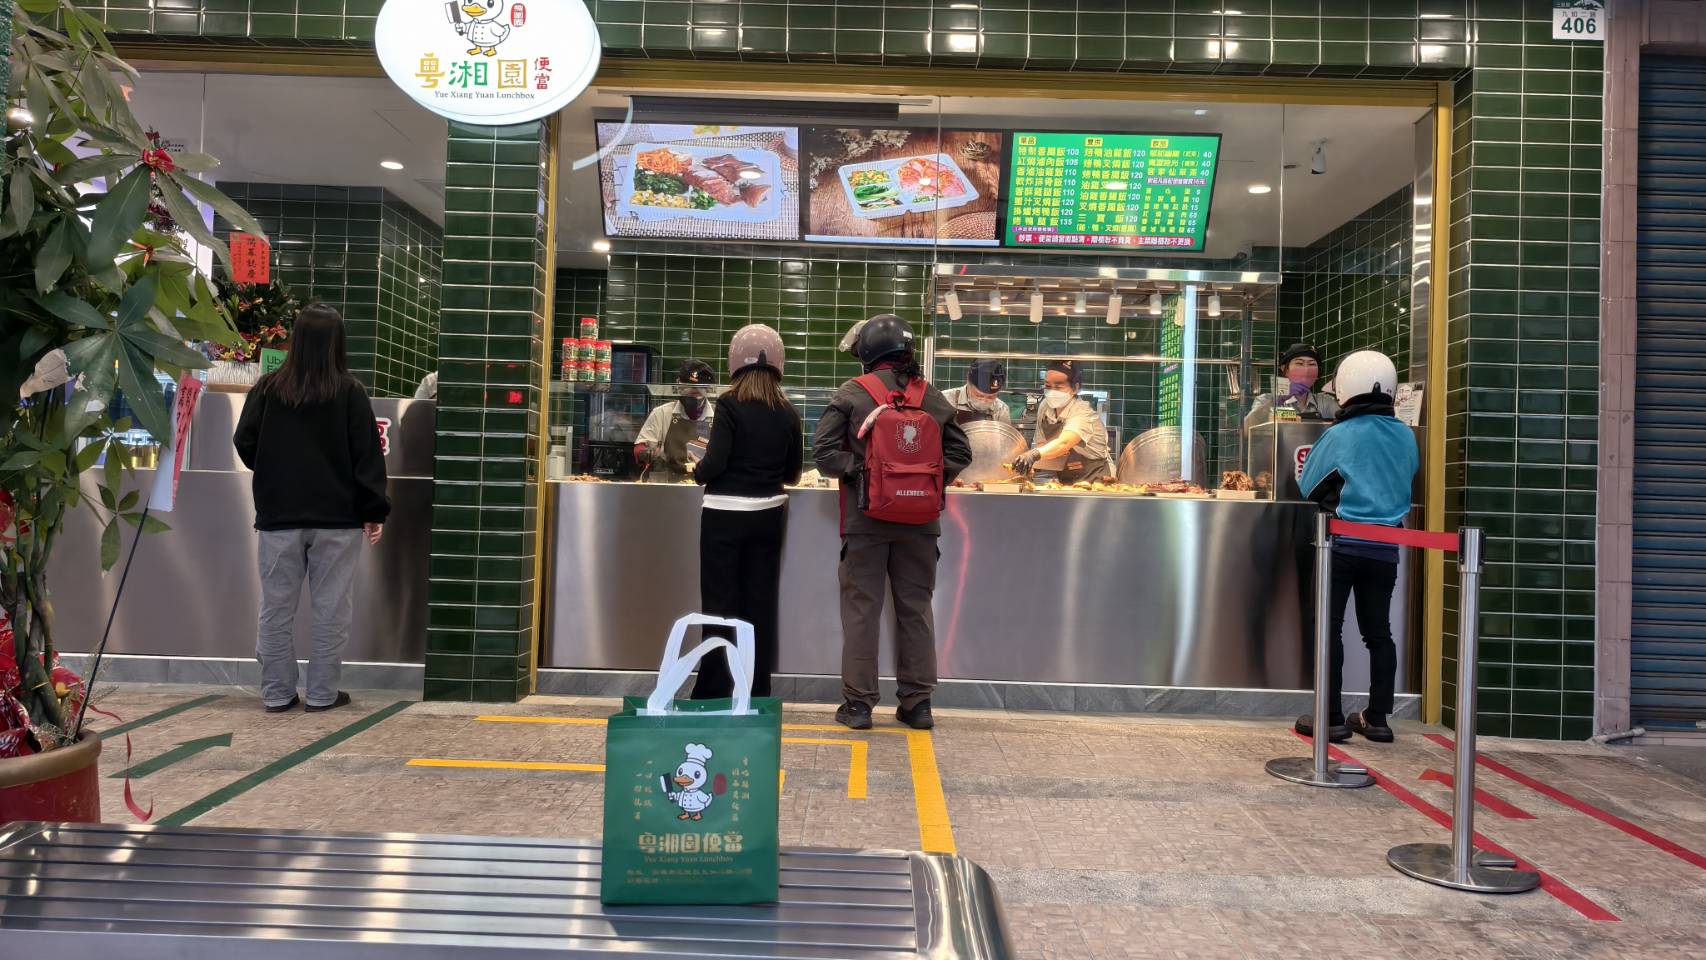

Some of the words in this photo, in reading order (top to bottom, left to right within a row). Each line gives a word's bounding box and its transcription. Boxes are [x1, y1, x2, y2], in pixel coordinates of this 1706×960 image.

[1561, 17, 1596, 34] 406
[415, 53, 528, 88] 粵湘園
[534, 56, 552, 89] 便當
[451, 91, 473, 99] Xiang
[496, 91, 535, 99] Lunchbox
[1060, 218, 1073, 226] 135
[638, 831, 744, 854] 粵湘園便當
